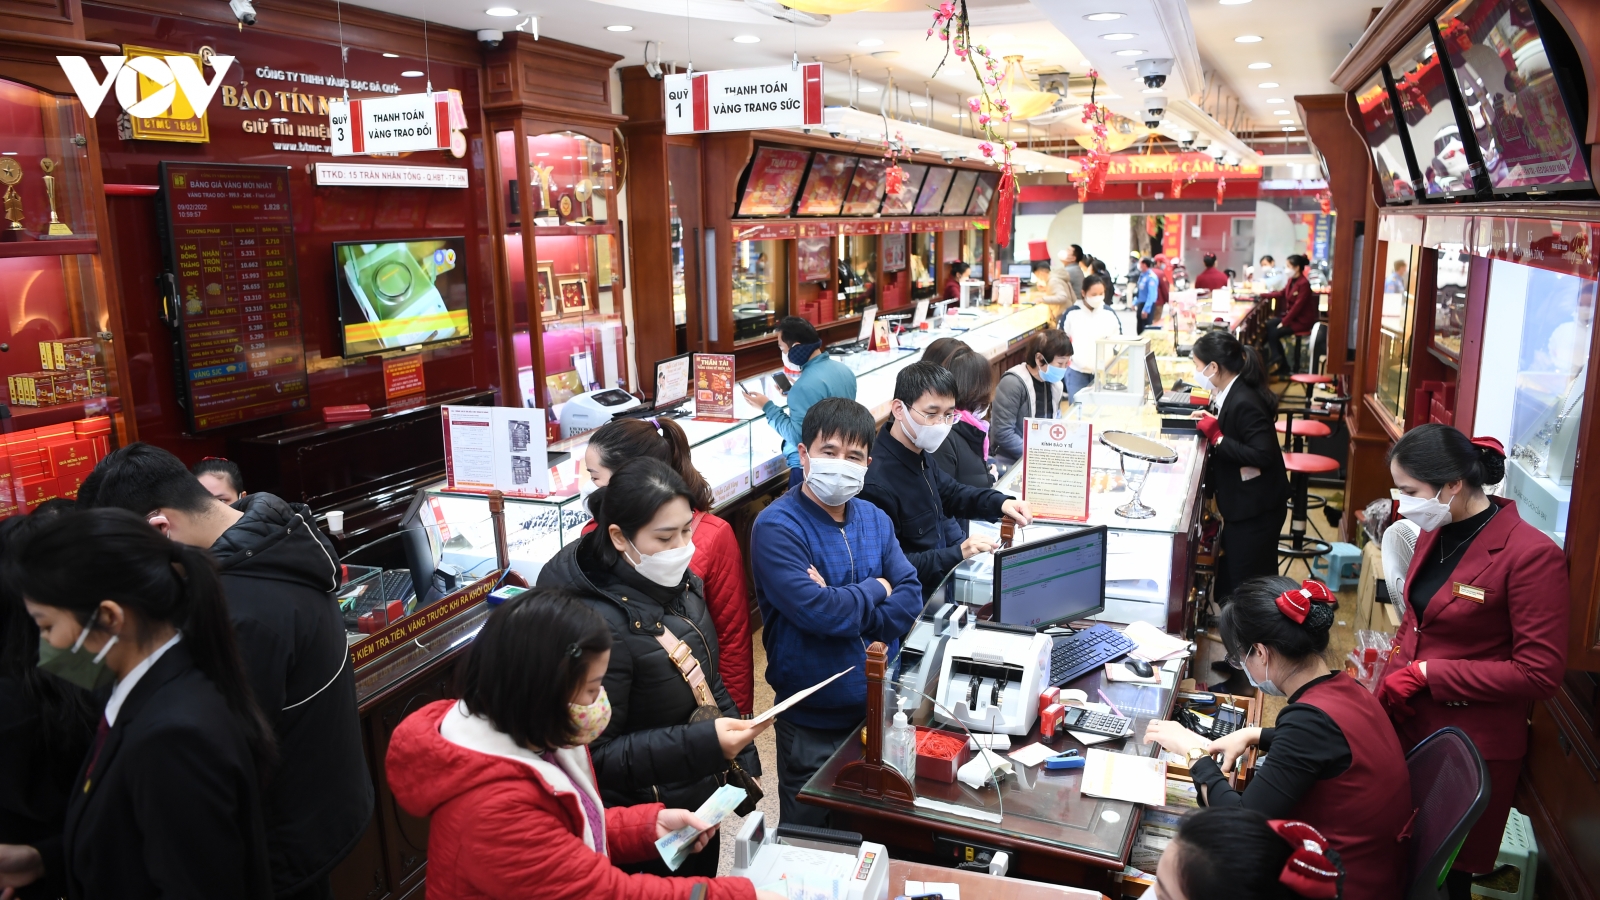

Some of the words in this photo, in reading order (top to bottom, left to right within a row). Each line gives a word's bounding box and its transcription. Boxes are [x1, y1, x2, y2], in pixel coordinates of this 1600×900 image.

[256, 66, 284, 81] CÔNG
[285, 71, 298, 82] TY
[300, 72, 324, 85] TNHH
[760, 81, 788, 93] TOÁN
[222, 80, 272, 111] BẢO
[275, 88, 314, 114] TÍN
[669, 89, 688, 101] QUỸ
[675, 103, 682, 118] 1
[713, 103, 742, 115] VÀNG
[744, 101, 777, 112] TRANG
[780, 98, 801, 110] SỨC
[332, 115, 348, 125] QUỸ
[373, 113, 400, 123] THANH
[402, 110, 425, 121] TOÁN
[242, 118, 269, 134] GIỮ
[368, 128, 392, 139] VÀNG
[393, 128, 414, 138] TRAO
[416, 121, 432, 136] ĐỔI
[337, 128, 345, 142] 3
[322, 170, 347, 179] TTKD:
[349, 171, 357, 179] 15
[404, 171, 421, 181] TÔNG
[190, 180, 209, 189] BẢNG
[211, 180, 222, 188] GIÁ
[212, 368, 222, 376] SJC
[376, 637, 389, 650] TRA
[408, 615, 426, 633] VÀNG
[427, 604, 448, 623] TRƯỚC
[450, 598, 460, 611] KHI
[461, 594, 469, 607] RA
[469, 586, 482, 600] KHỎI
